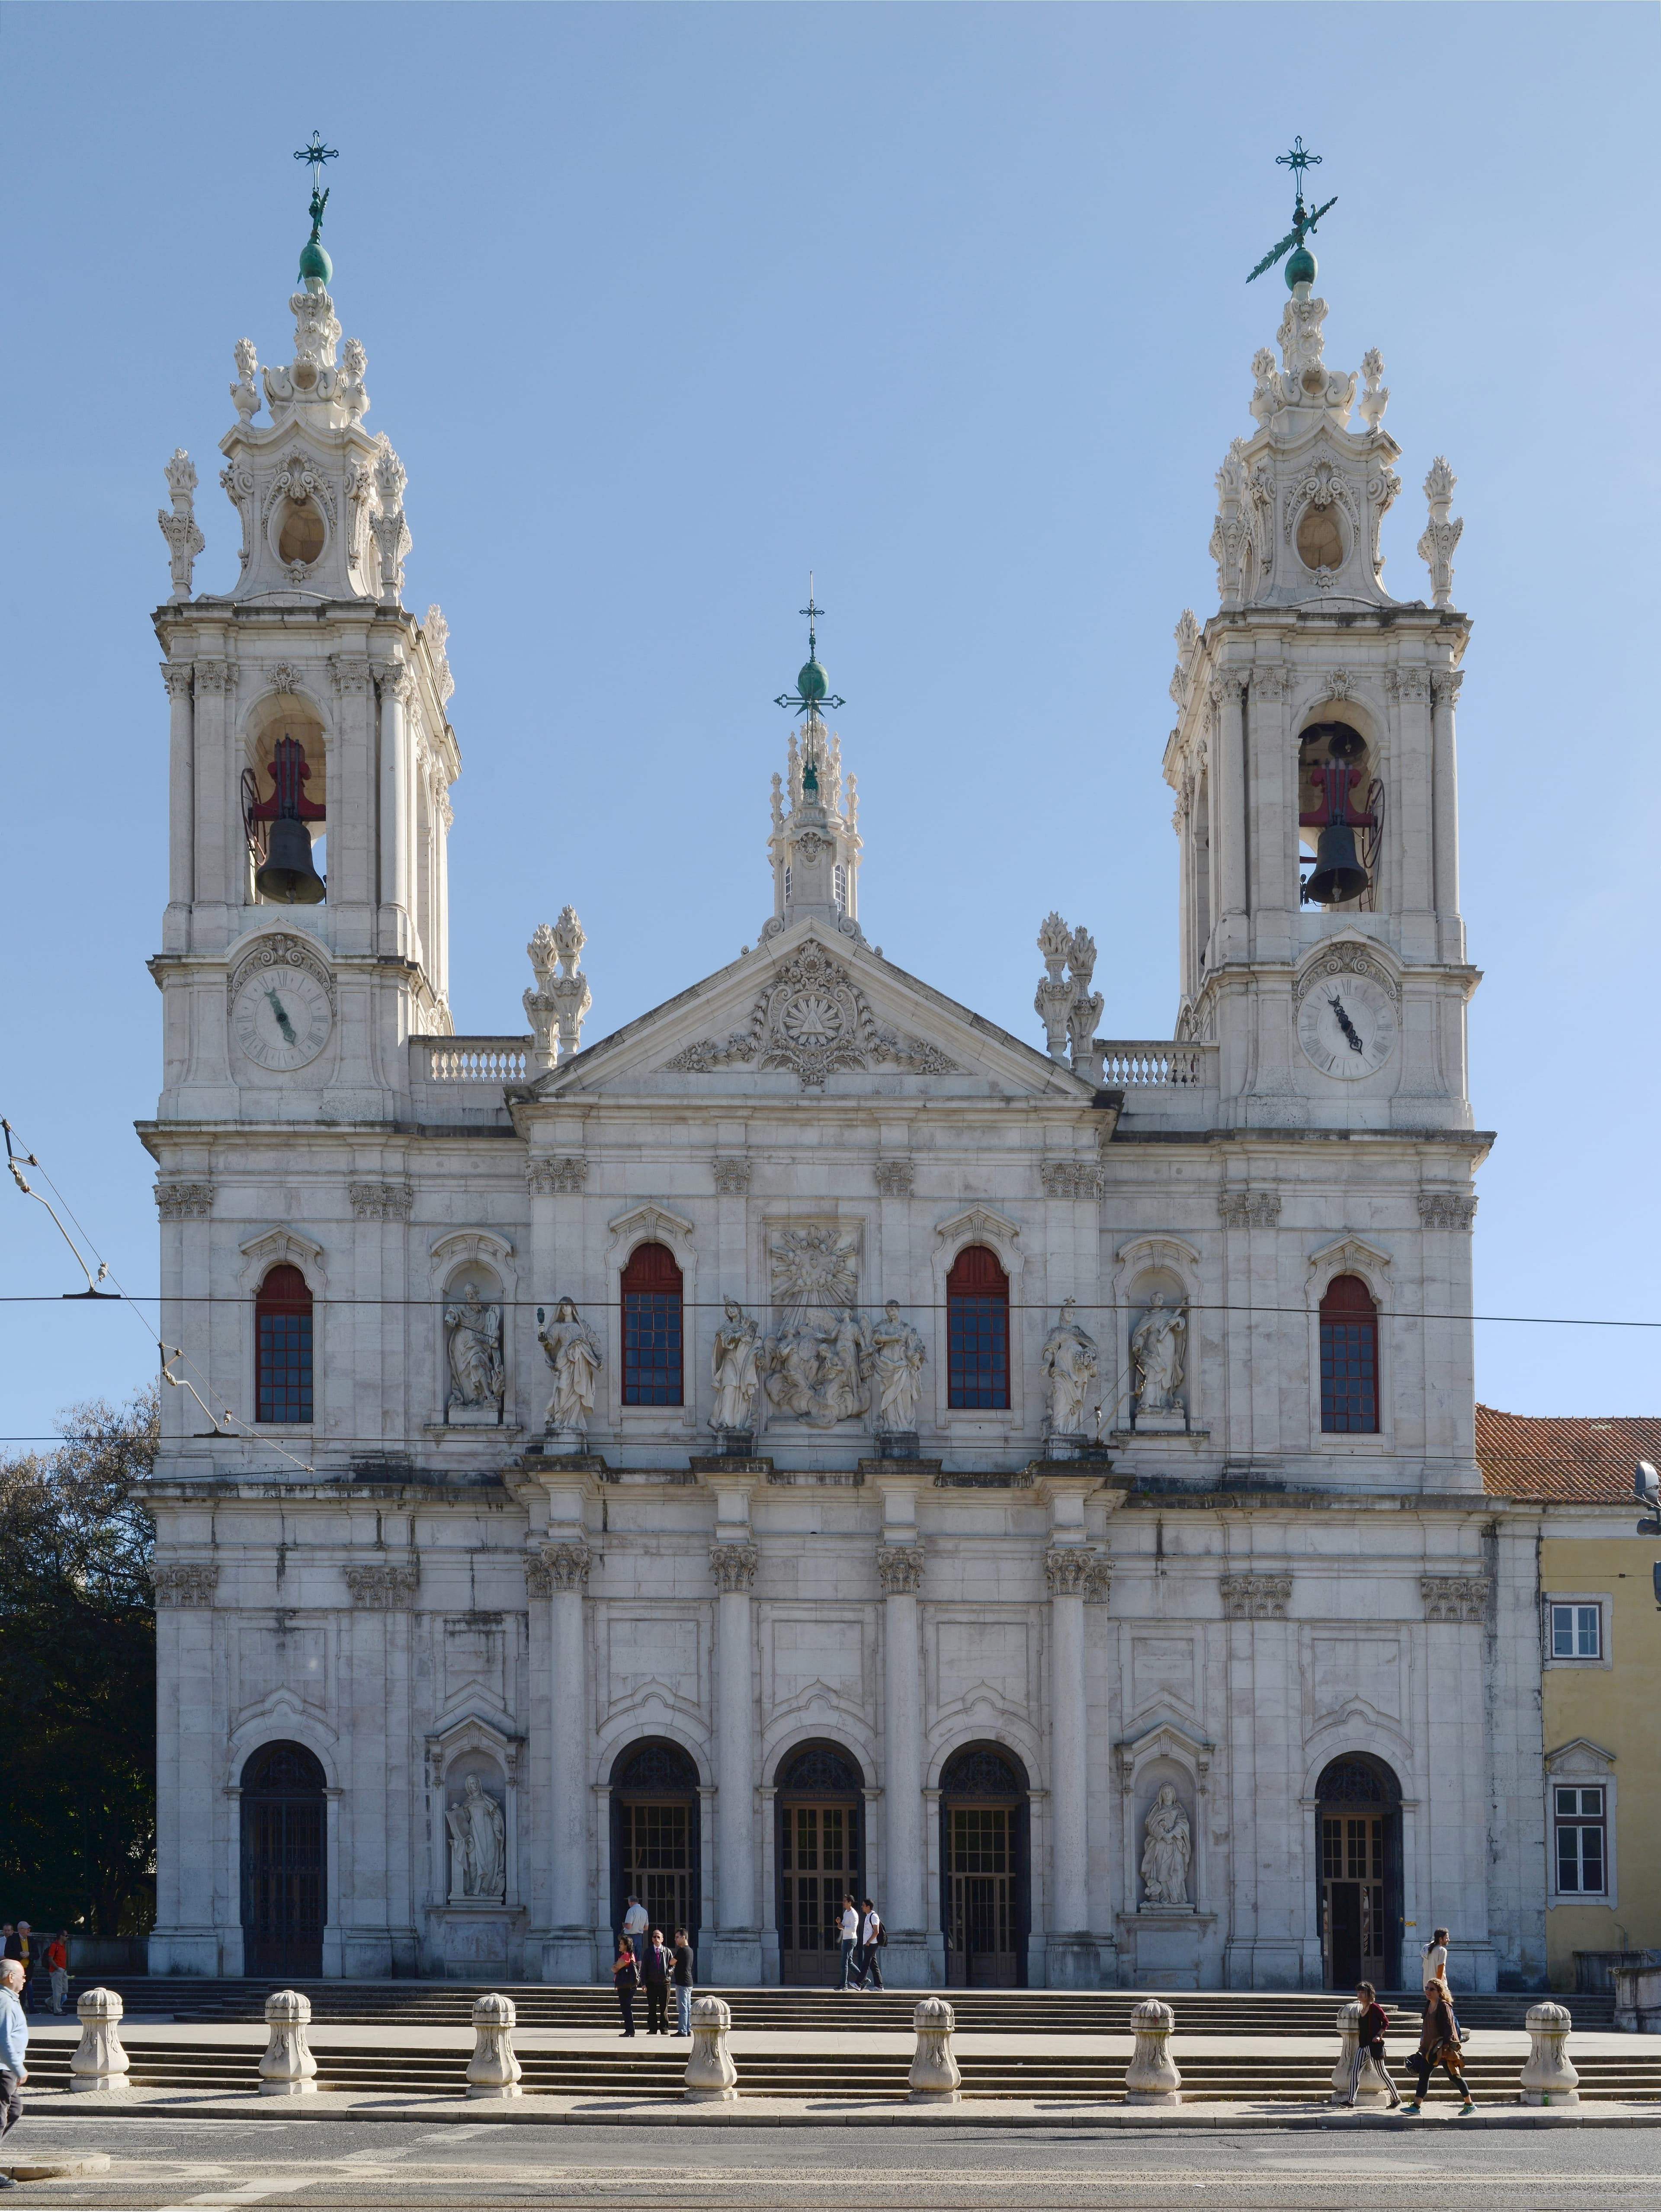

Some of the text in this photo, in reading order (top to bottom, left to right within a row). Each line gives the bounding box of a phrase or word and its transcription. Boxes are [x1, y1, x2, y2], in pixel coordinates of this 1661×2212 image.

[277, 970, 288, 986] XII
[297, 977, 305, 991] I
[307, 993, 323, 1004] II
